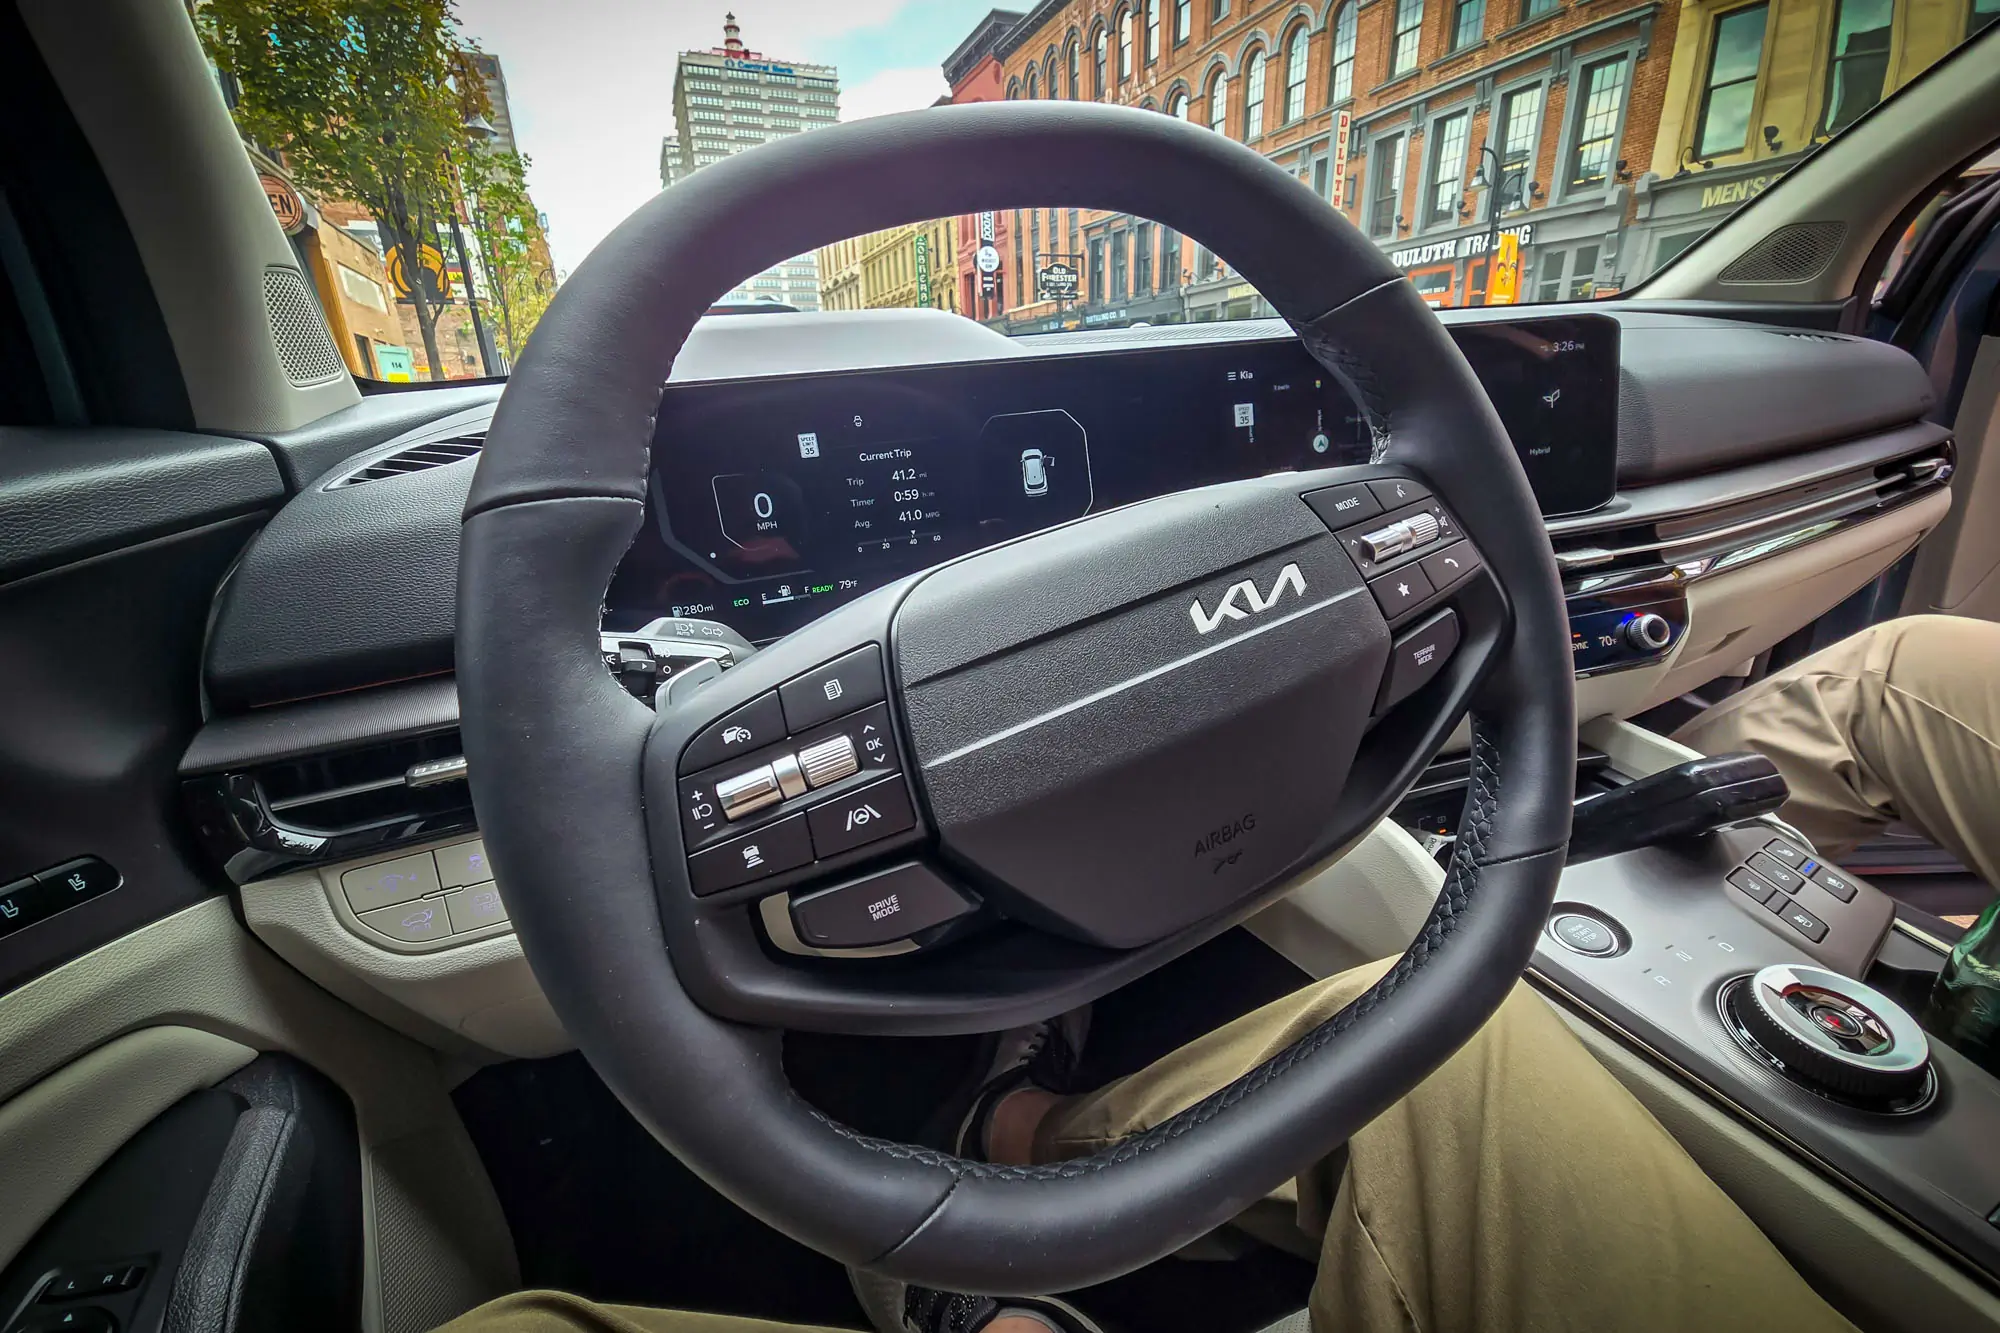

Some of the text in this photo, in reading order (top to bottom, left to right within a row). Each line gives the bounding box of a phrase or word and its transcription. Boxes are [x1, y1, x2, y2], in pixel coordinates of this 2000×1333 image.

[1333, 114, 1348, 206] DULUTH
[267, 193, 293, 215] EN
[1392, 225, 1532, 268] DULUTH TRNG
[1552, 341, 1575, 352] 3:26
[1240, 371, 1253, 379] Kia
[1239, 416, 1250, 425] 35
[859, 449, 912, 462] Current Trip
[1529, 446, 1551, 456] Hybrid
[846, 477, 865, 488] Trip
[892, 469, 916, 481] 41.2
[851, 499, 874, 507] Timer
[894, 489, 919, 502] 0:59
[1335, 497, 1360, 512] MODE
[753, 492, 773, 519] 0
[756, 520, 778, 531] MPH
[854, 520, 873, 529] Avg.
[899, 510, 922, 522] 41.0
[804, 586, 810, 594] F
[812, 584, 834, 594] READY
[733, 598, 750, 607] ECO
[1413, 643, 1436, 660] TERRAIN
[1572, 641, 1589, 651] SYNC
[1417, 652, 1433, 666] MODE
[866, 737, 884, 751] OK
[1194, 813, 1256, 858] AIRBAG
[867, 894, 898, 914] DRIVE
[872, 903, 900, 921] MODE
[1572, 927, 1593, 940] START
[1581, 932, 1597, 944] STOP
[1718, 942, 1735, 953] D
[1676, 951, 1693, 962] N
[1653, 975, 1671, 986] R
